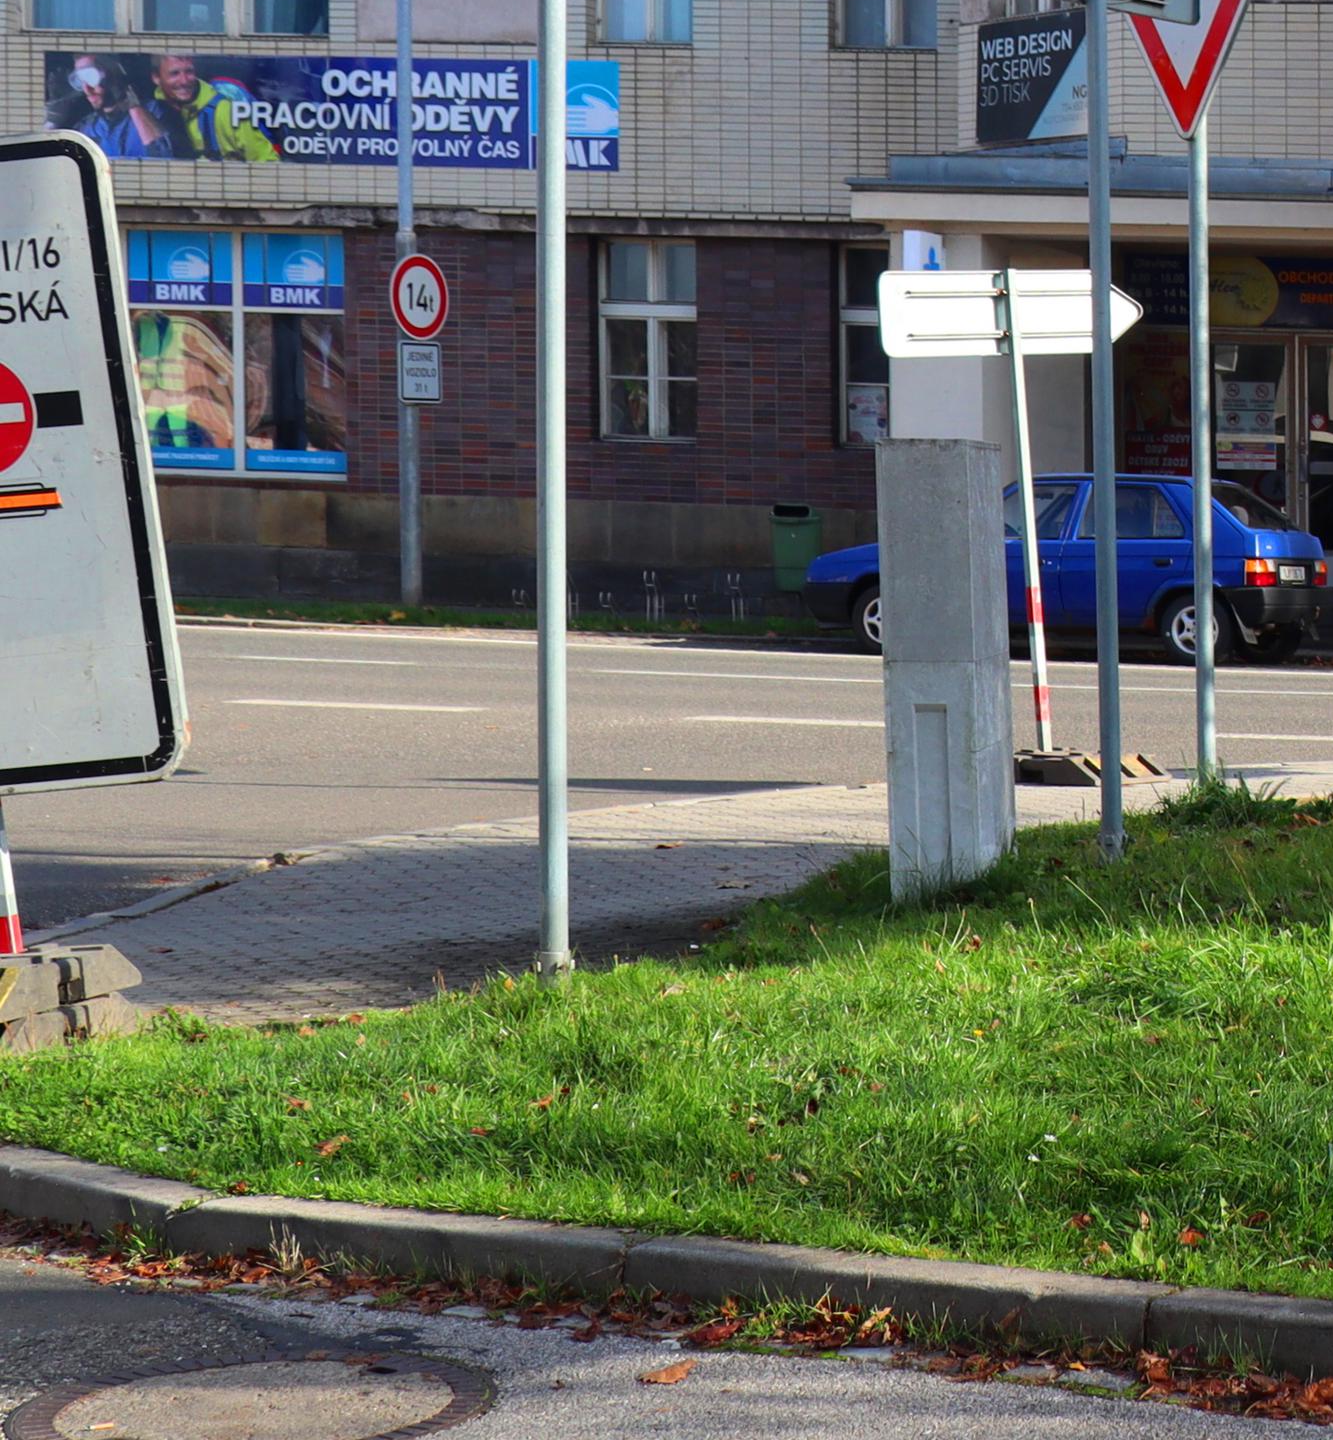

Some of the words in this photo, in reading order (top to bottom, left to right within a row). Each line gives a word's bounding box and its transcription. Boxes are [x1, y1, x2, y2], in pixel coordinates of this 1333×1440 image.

[981, 37, 1014, 60] WEB
[1018, 28, 1072, 56] DESIGN
[322, 66, 519, 100] OCHRANNÉ
[981, 62, 999, 83] PC
[1002, 56, 1052, 81] SERVIS
[979, 85, 998, 107] 3D
[1001, 82, 1031, 105] TISK
[231, 98, 392, 130] PRACOVNÍ
[283, 132, 352, 155] ODĚVY
[357, 138, 399, 157] PRO
[412, 136, 472, 157] OLNÝ
[477, 135, 520, 159] ČAS
[566, 140, 611, 167] MK
[155, 283, 206, 302] BMK
[270, 286, 321, 305] BMK
